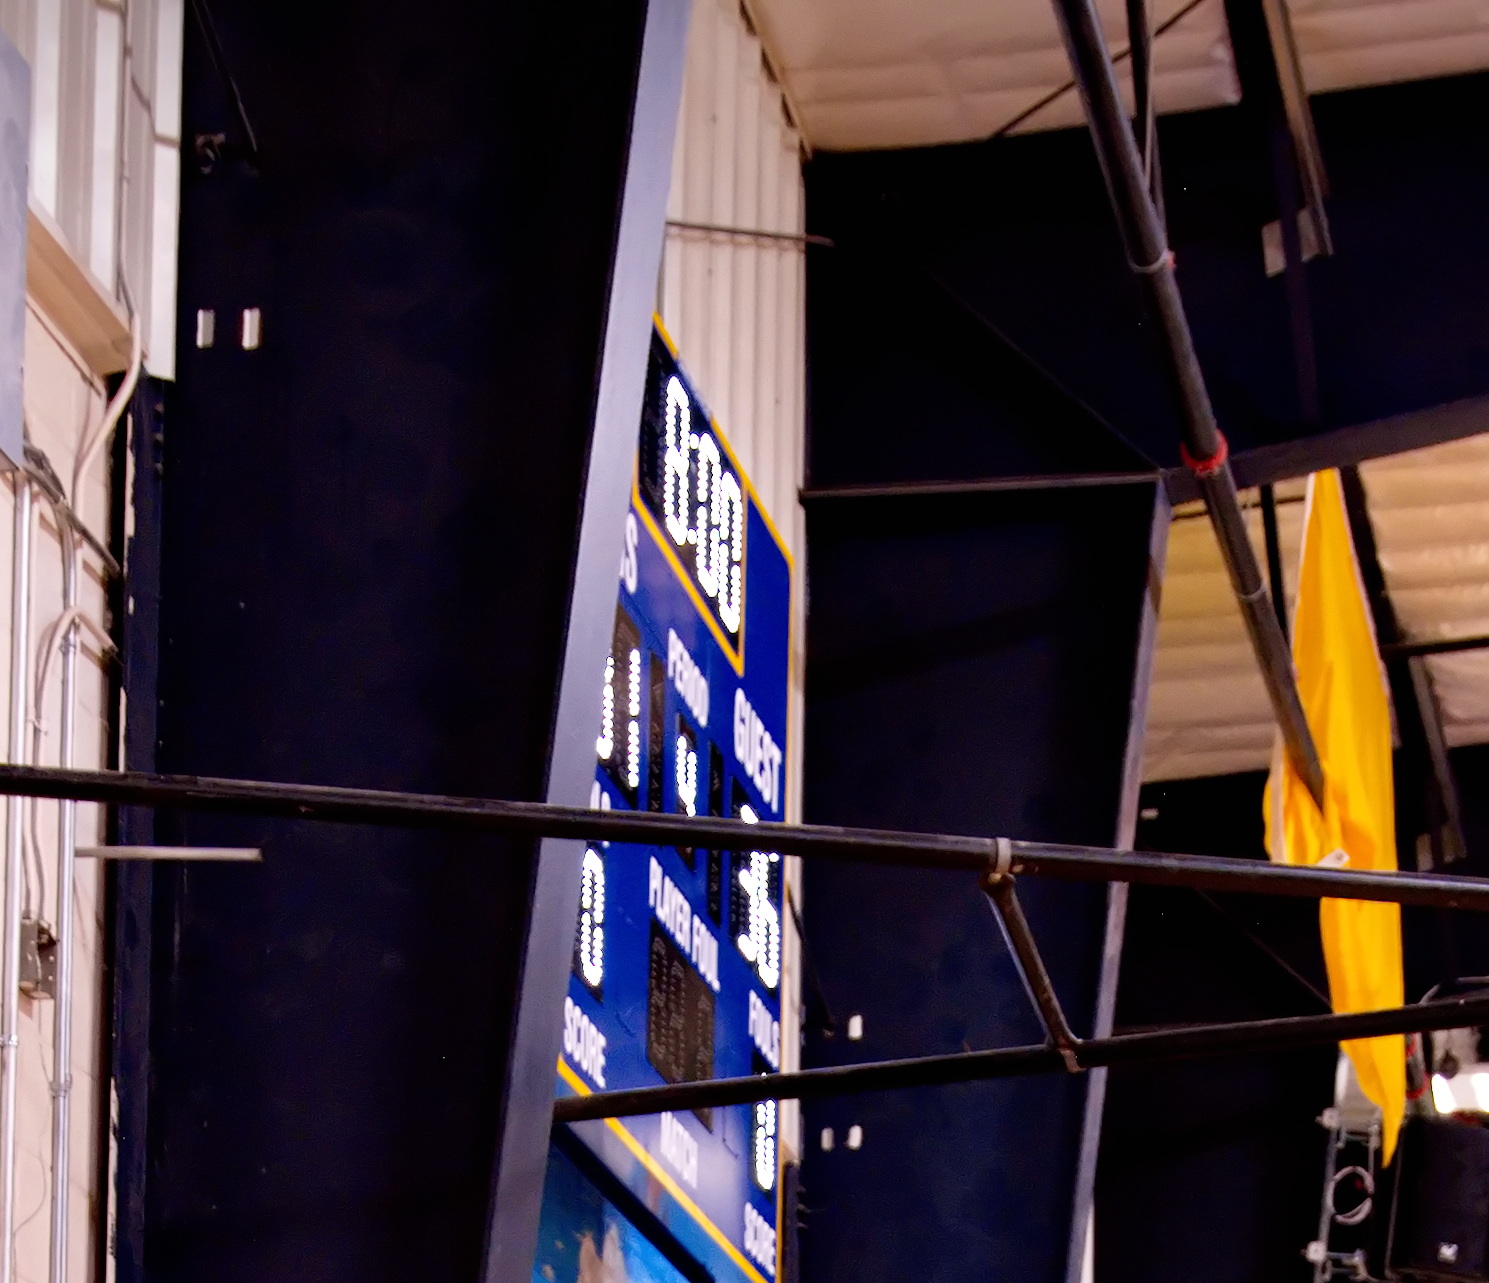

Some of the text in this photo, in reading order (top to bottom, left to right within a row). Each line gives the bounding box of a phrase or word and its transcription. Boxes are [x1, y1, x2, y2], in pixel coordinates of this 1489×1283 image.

[668, 628, 710, 728] PERIOD
[734, 687, 782, 813] GUEST
[648, 855, 721, 993] PLAYER FOUL
[563, 995, 606, 1089] SCORE
[744, 1201, 776, 1277] SCORE
